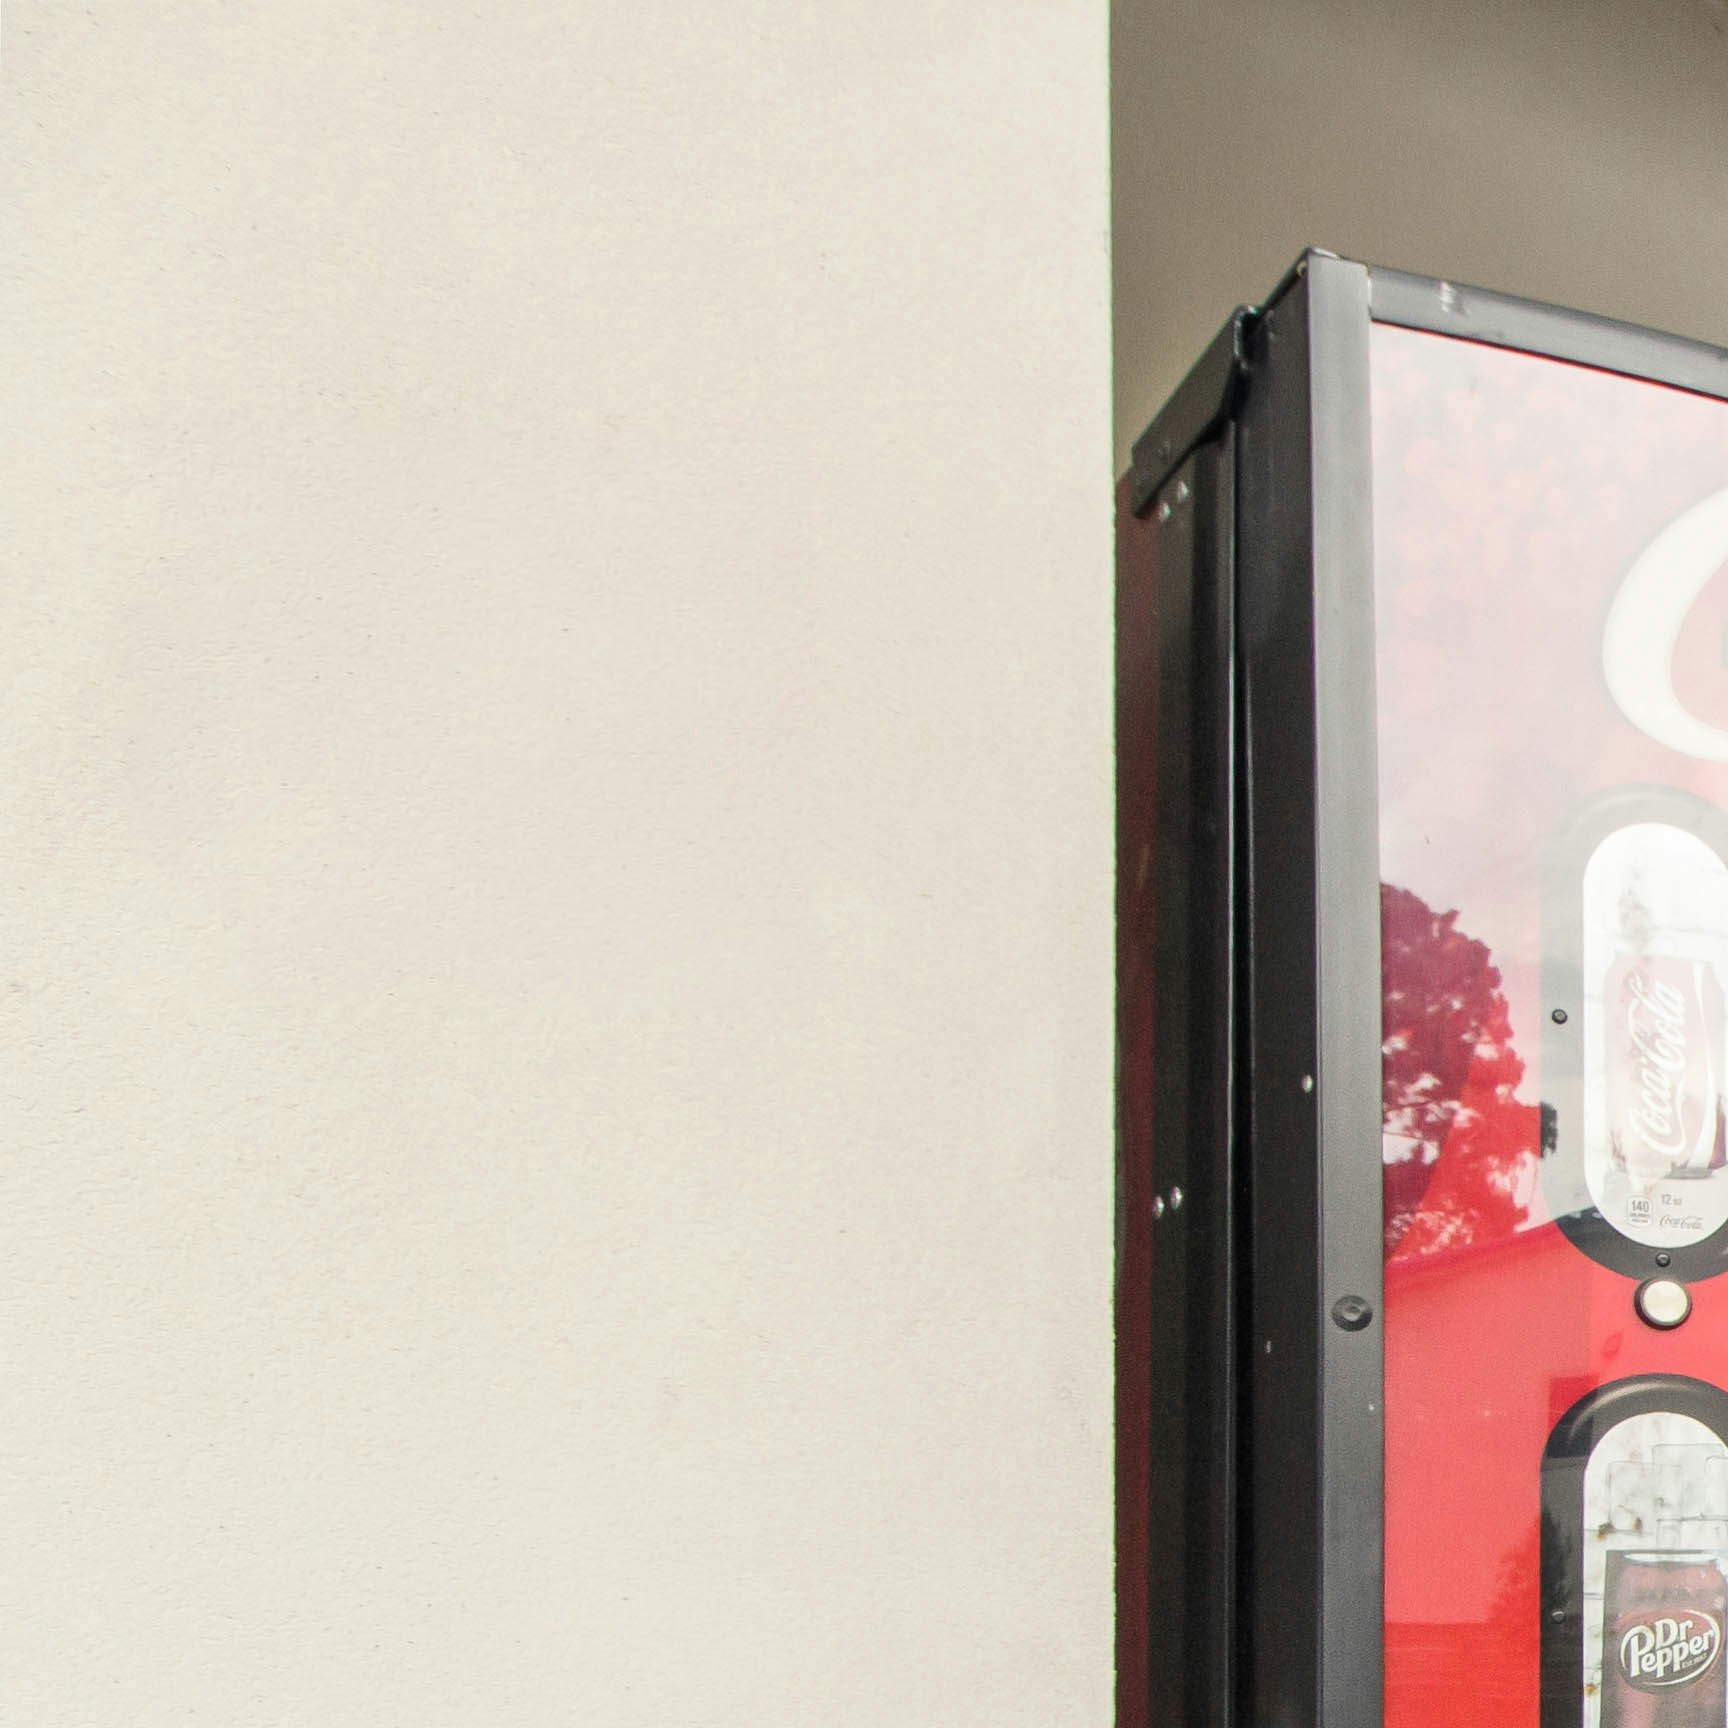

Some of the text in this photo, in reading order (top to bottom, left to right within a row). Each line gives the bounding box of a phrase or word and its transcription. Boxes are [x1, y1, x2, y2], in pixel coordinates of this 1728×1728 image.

[1631, 1200, 1650, 1213] 140
[1654, 1618, 1694, 1651] Dr
[1621, 1625, 1714, 1679] Pepper
